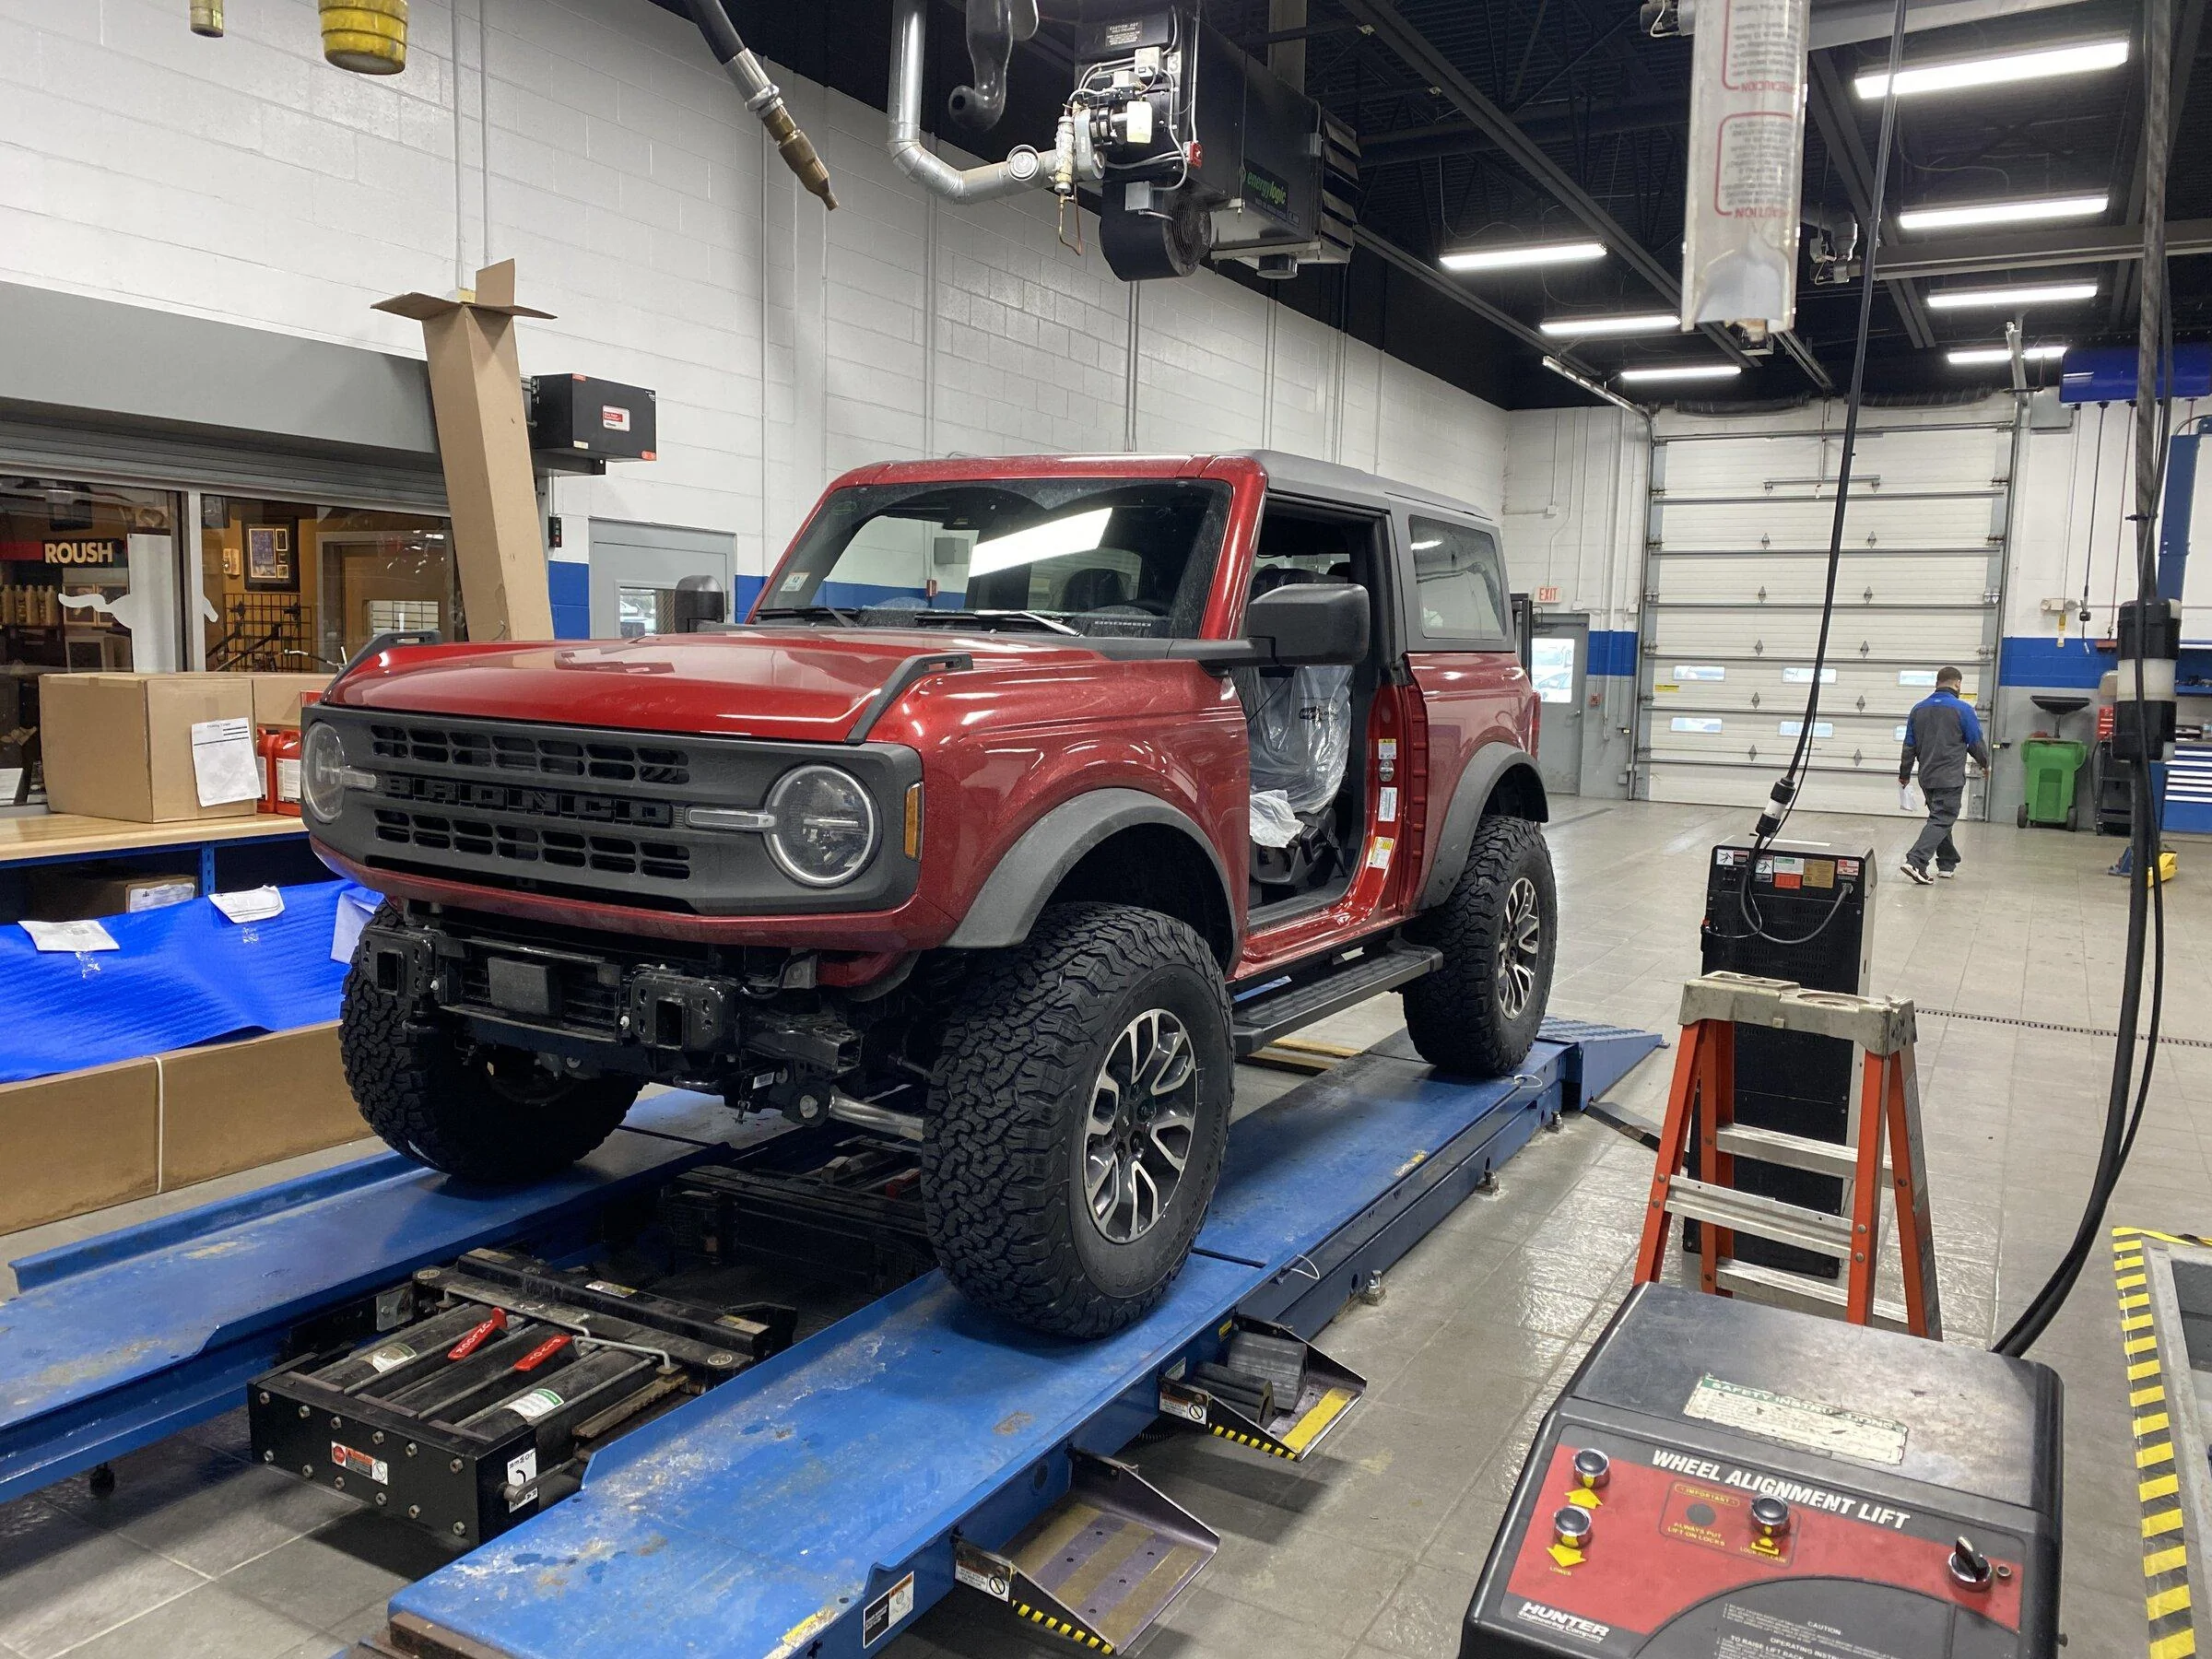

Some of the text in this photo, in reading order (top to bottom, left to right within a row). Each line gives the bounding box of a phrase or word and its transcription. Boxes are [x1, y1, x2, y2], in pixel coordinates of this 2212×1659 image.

[1247, 171, 1287, 205] energylogic
[45, 542, 112, 563] ROUSH
[1539, 587, 1558, 601] EXIT
[383, 772, 672, 827] BRONCO
[1712, 1382, 1894, 1429] SAFETY INSTRUTIONS
[1652, 1450, 1911, 1529] WHEEL ALIGNMENT LIFT
[1685, 1487, 1730, 1504] IMPORTANT
[1668, 1525, 1684, 1535] LIFT
[1699, 1535, 1725, 1547] LOCKS
[1674, 1522, 1723, 1539] ALWAYS PUT
[1549, 1566, 1572, 1577] LOWER
[1518, 1610, 1604, 1642] Engineering Company
[1522, 1601, 1610, 1637] HUNTER
[1807, 1620, 1841, 1636] CAUTION
[1732, 1634, 1741, 1642] TO
[1742, 1638, 1764, 1650] RAISE
[1765, 1645, 1782, 1654] LIFT
[1770, 1637, 1813, 1655] OPERATING
